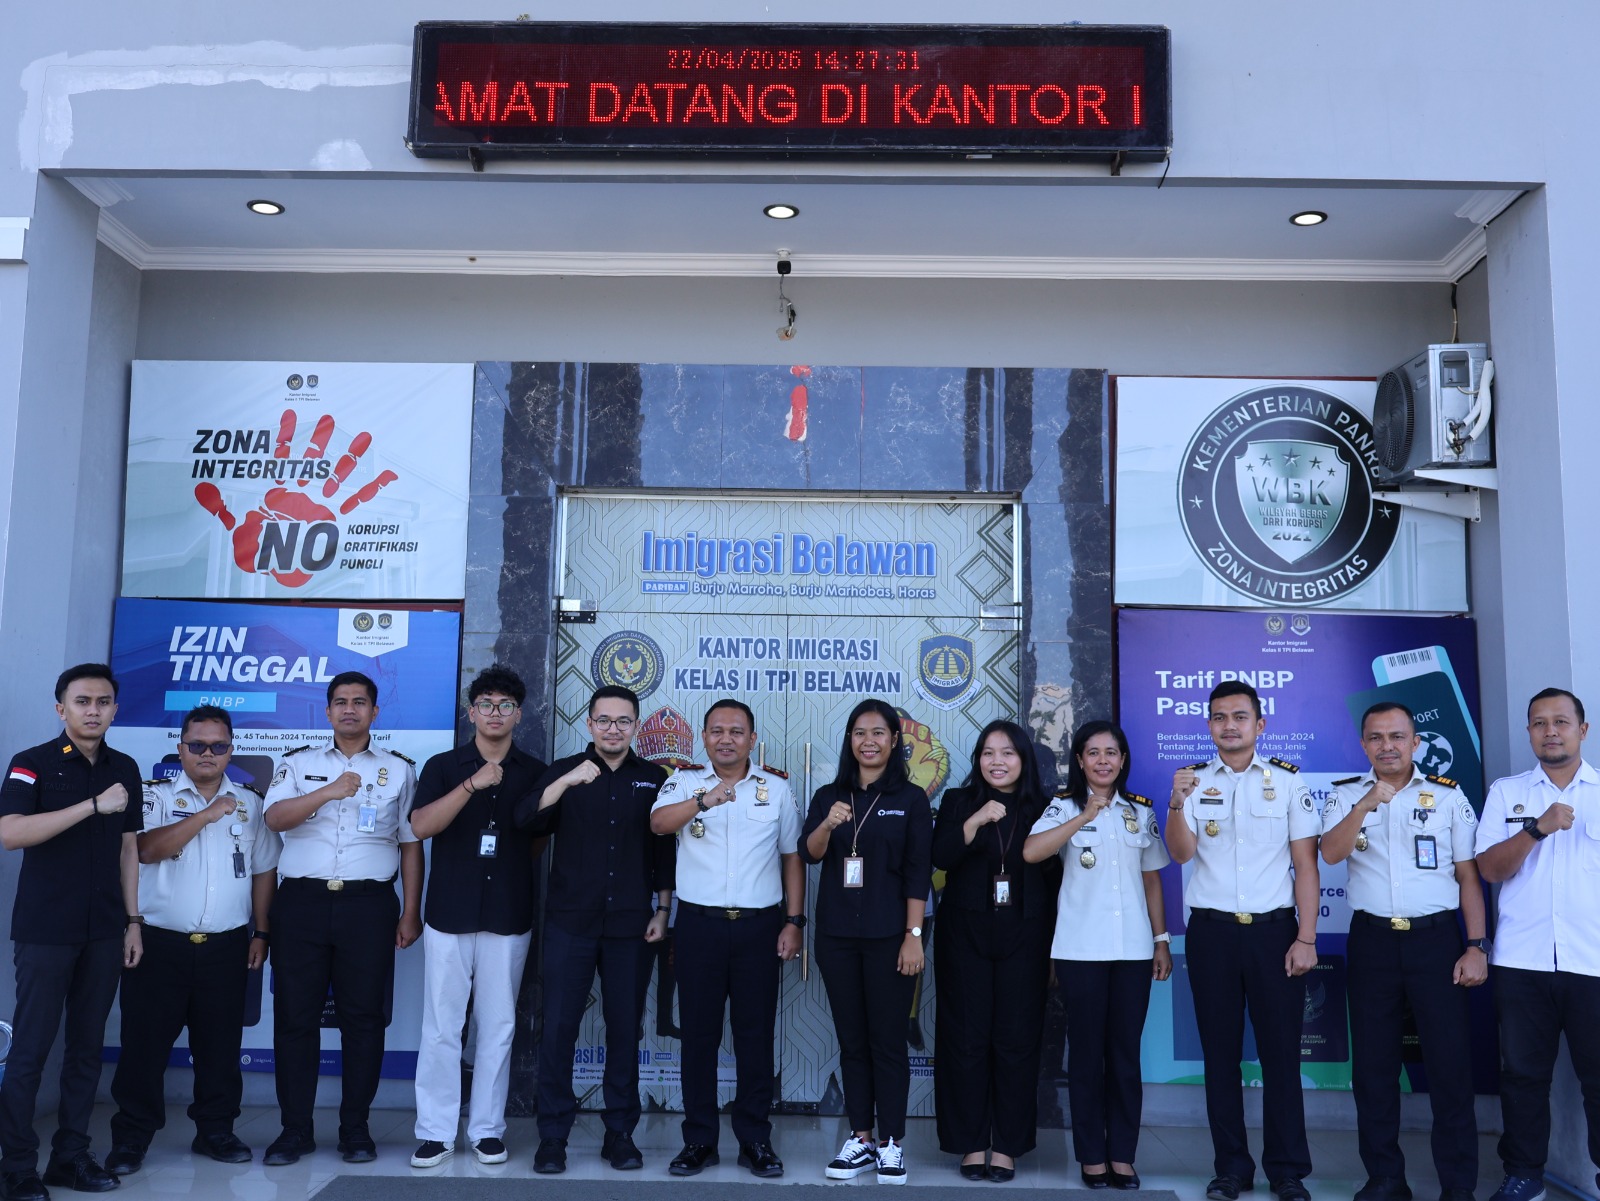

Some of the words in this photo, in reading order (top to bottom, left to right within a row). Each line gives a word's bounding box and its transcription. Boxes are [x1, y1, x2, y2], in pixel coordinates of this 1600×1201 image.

[668, 47, 801, 69] 22/04/2026
[814, 50, 920, 70] 14:27:31
[589, 82, 798, 124] DATANG
[821, 84, 867, 124] DI
[894, 84, 1109, 125] KANTOR
[192, 430, 270, 454] ZONA
[1192, 395, 1332, 472] KEMENTERIAN
[192, 459, 331, 480] INTEGRITAS
[1252, 476, 1331, 506] WBK
[1259, 506, 1297, 518] WILAYAH
[1299, 508, 1328, 519] BEBAS
[347, 524, 400, 535] KORUPSI
[1263, 517, 1283, 526] DARI
[1286, 518, 1323, 528] KORUPSI
[1272, 530, 1312, 542] 2021
[257, 522, 340, 572] NO
[344, 541, 419, 552] GRATIFIKASI
[642, 531, 784, 578] Imigrasi
[791, 533, 936, 577] Belawan
[340, 558, 383, 570] PUNGLI
[1207, 542, 1252, 589] ZONA
[1256, 554, 1368, 600] INTEGRITAS
[645, 584, 687, 592] PARIBAN
[693, 582, 724, 596] Burju
[728, 583, 786, 597] Marroha,
[790, 584, 822, 598] Burju
[825, 585, 894, 599] Marhobas,
[899, 587, 935, 599] Horas
[169, 626, 248, 652] IZIN
[699, 637, 781, 659] KANTOR
[788, 638, 878, 660] IMIGRASI
[170, 655, 336, 683] TINGGAL
[674, 668, 739, 691] KELAS
[746, 669, 758, 691] II
[765, 670, 797, 691] TPI
[804, 671, 900, 693] BELAWAN
[931, 676, 961, 686] IMIGRASI
[1155, 670, 1215, 689] Tarif
[1220, 670, 1294, 689] PNBP
[199, 697, 245, 707] PNBP
[1157, 697, 1210, 718] Pasp
[1413, 708, 1440, 723] ORT
[244, 733, 253, 741] 45
[256, 733, 278, 741] Tahun
[280, 733, 299, 741] 2024
[301, 734, 332, 743] Tentang
[1157, 733, 1212, 741] Berdasarkan
[1262, 733, 1289, 741] Tahun
[1290, 733, 1315, 741] 2024
[1157, 743, 1195, 752] Tentang
[1196, 743, 1218, 751] Jenis
[1261, 743, 1282, 751] Atas
[1284, 743, 1306, 751] Jenis
[1158, 753, 1212, 761] Penerimaan
[1257, 753, 1275, 761] kan
[1277, 753, 1302, 762] Pajak
[575, 1046, 594, 1064] asi
[638, 1050, 650, 1065] an
[910, 1069, 935, 1077] PRIOR
